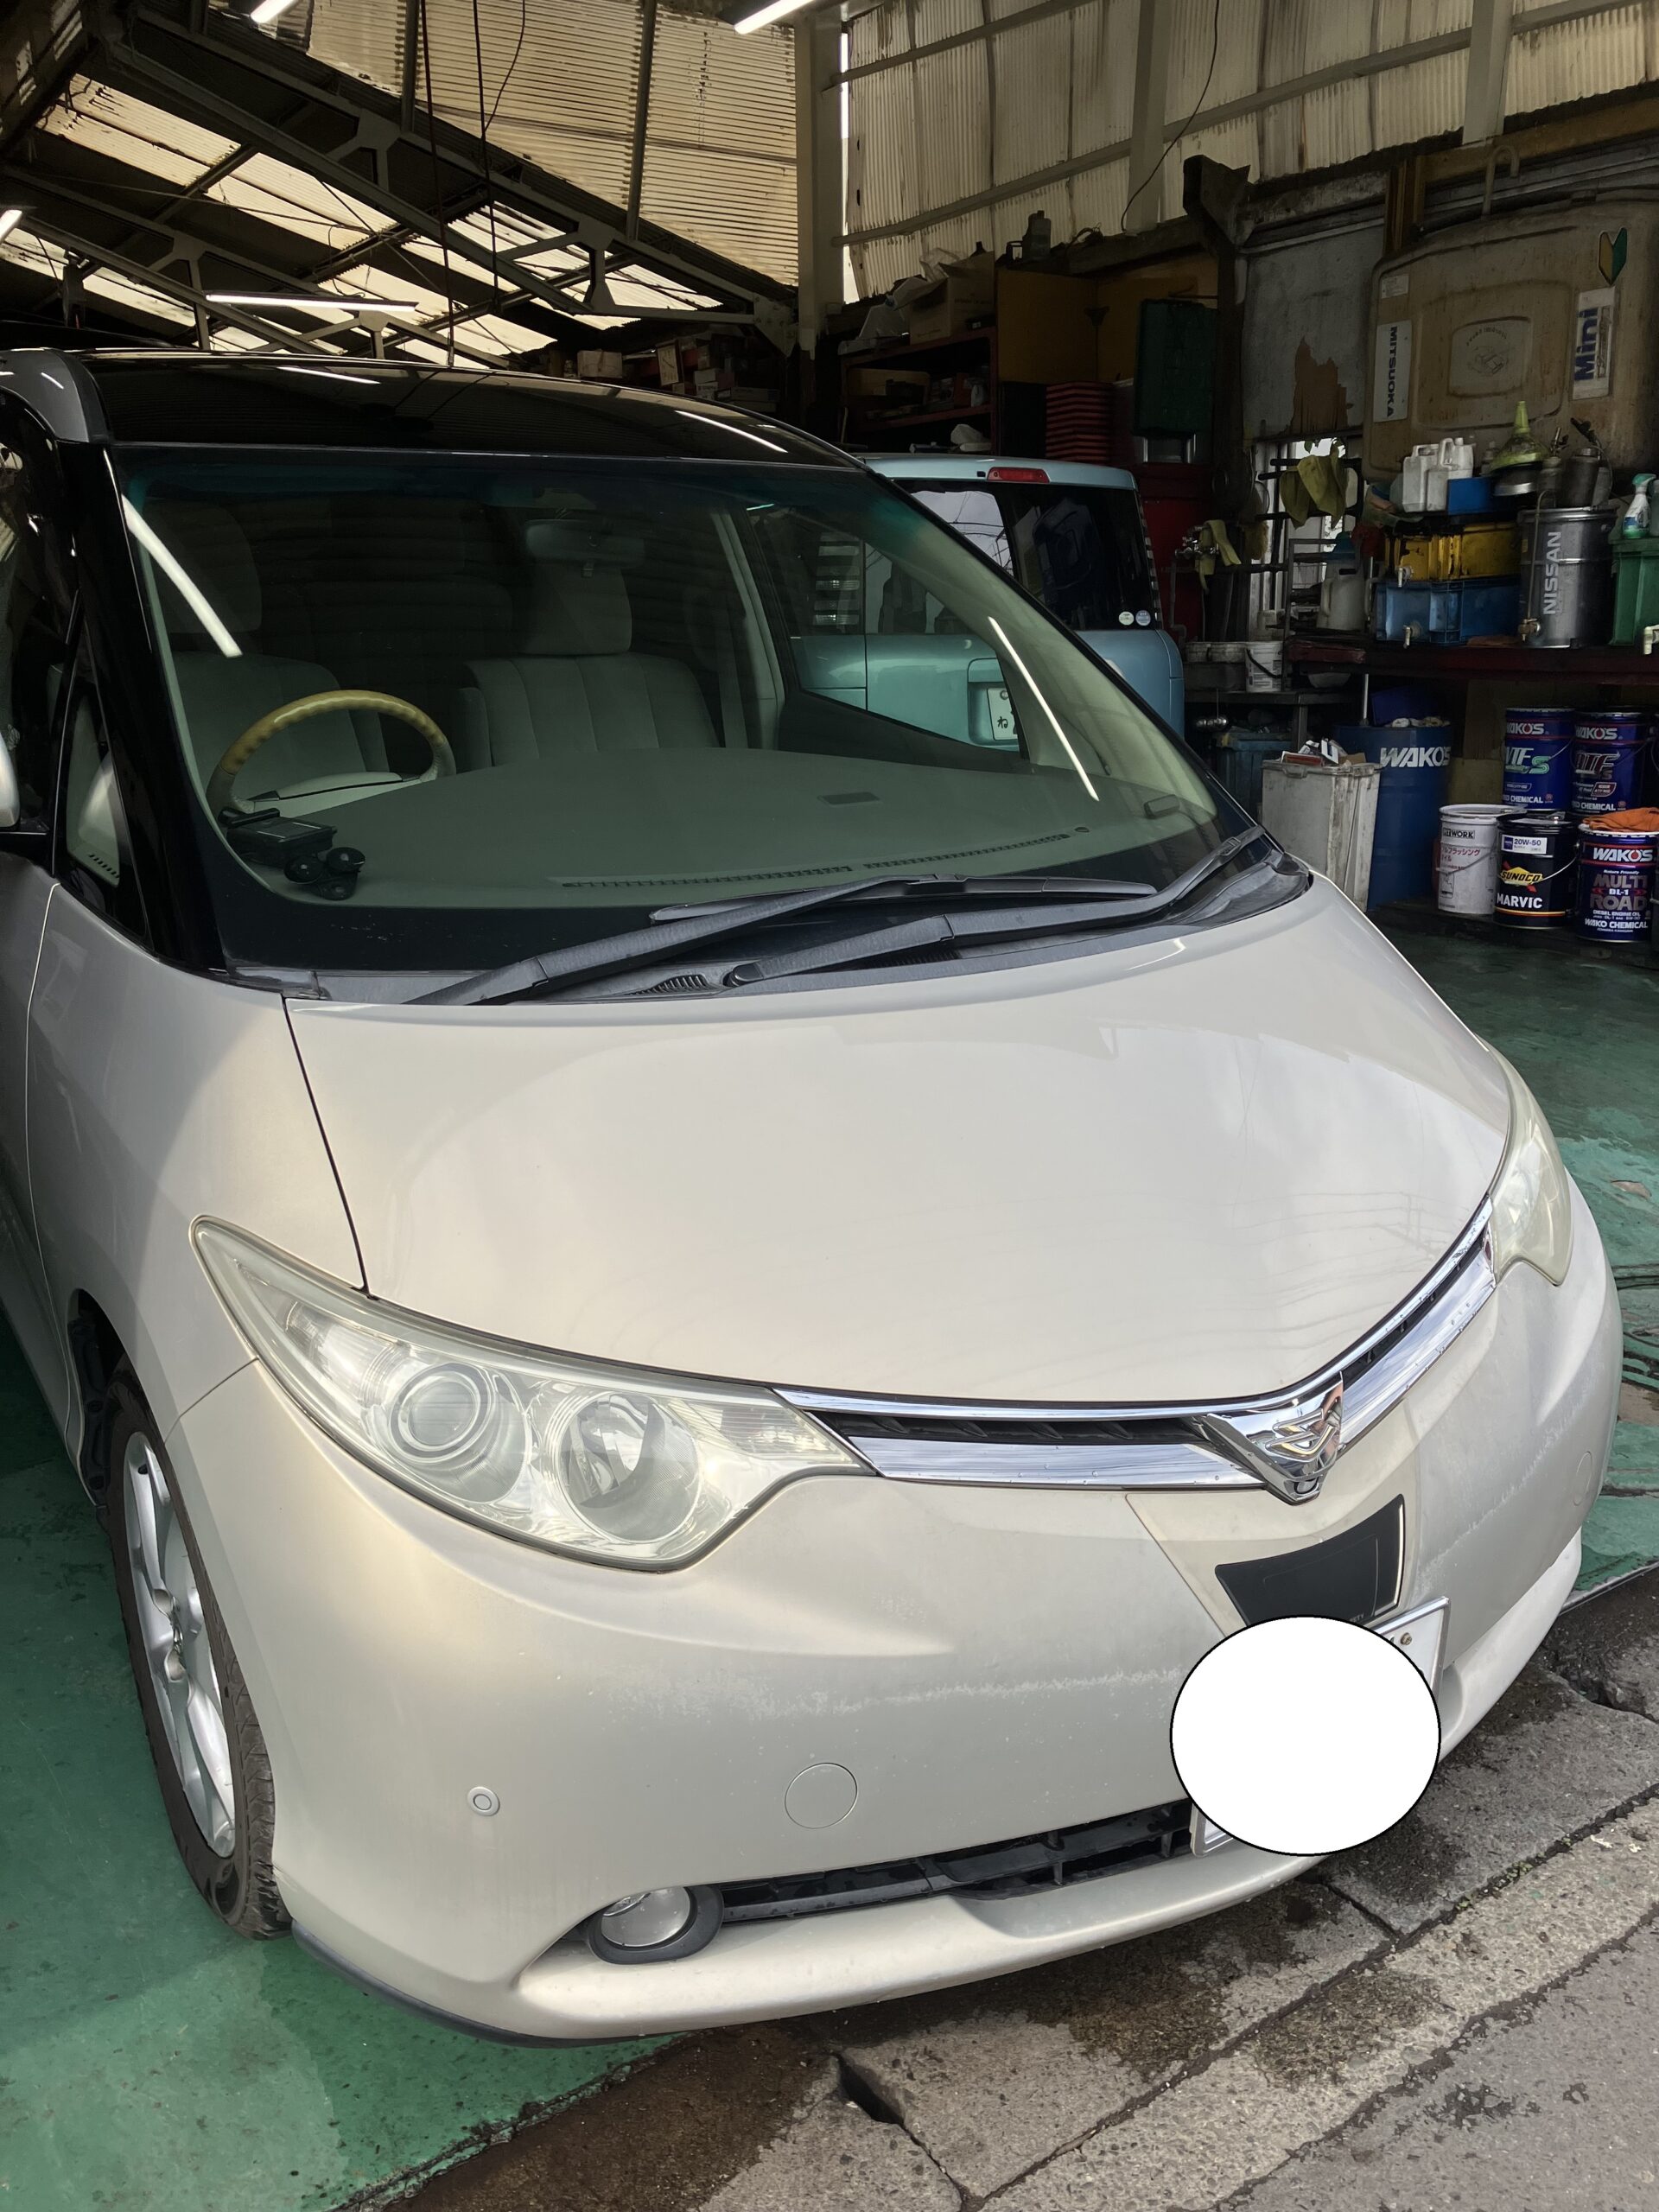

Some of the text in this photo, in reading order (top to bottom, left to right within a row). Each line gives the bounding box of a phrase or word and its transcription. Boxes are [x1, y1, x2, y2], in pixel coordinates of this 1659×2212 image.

[1574, 307, 1599, 381] Mini
[1387, 326, 1398, 417] MITSUOKA
[1543, 531, 1561, 615] NISSAN
[997, 716, 1008, 729] ね
[1510, 795, 1544, 804] CHEMICAL
[1581, 802, 1617, 811] CHEMICAL
[1514, 838, 1541, 847] 20W-50
[1501, 871, 1541, 883] SUNOCO
[1592, 874, 1649, 888] MULTI
[1497, 893, 1542, 908] MARVIC
[1590, 893, 1648, 911] ROAD
[1585, 918, 1608, 928] WAKO
